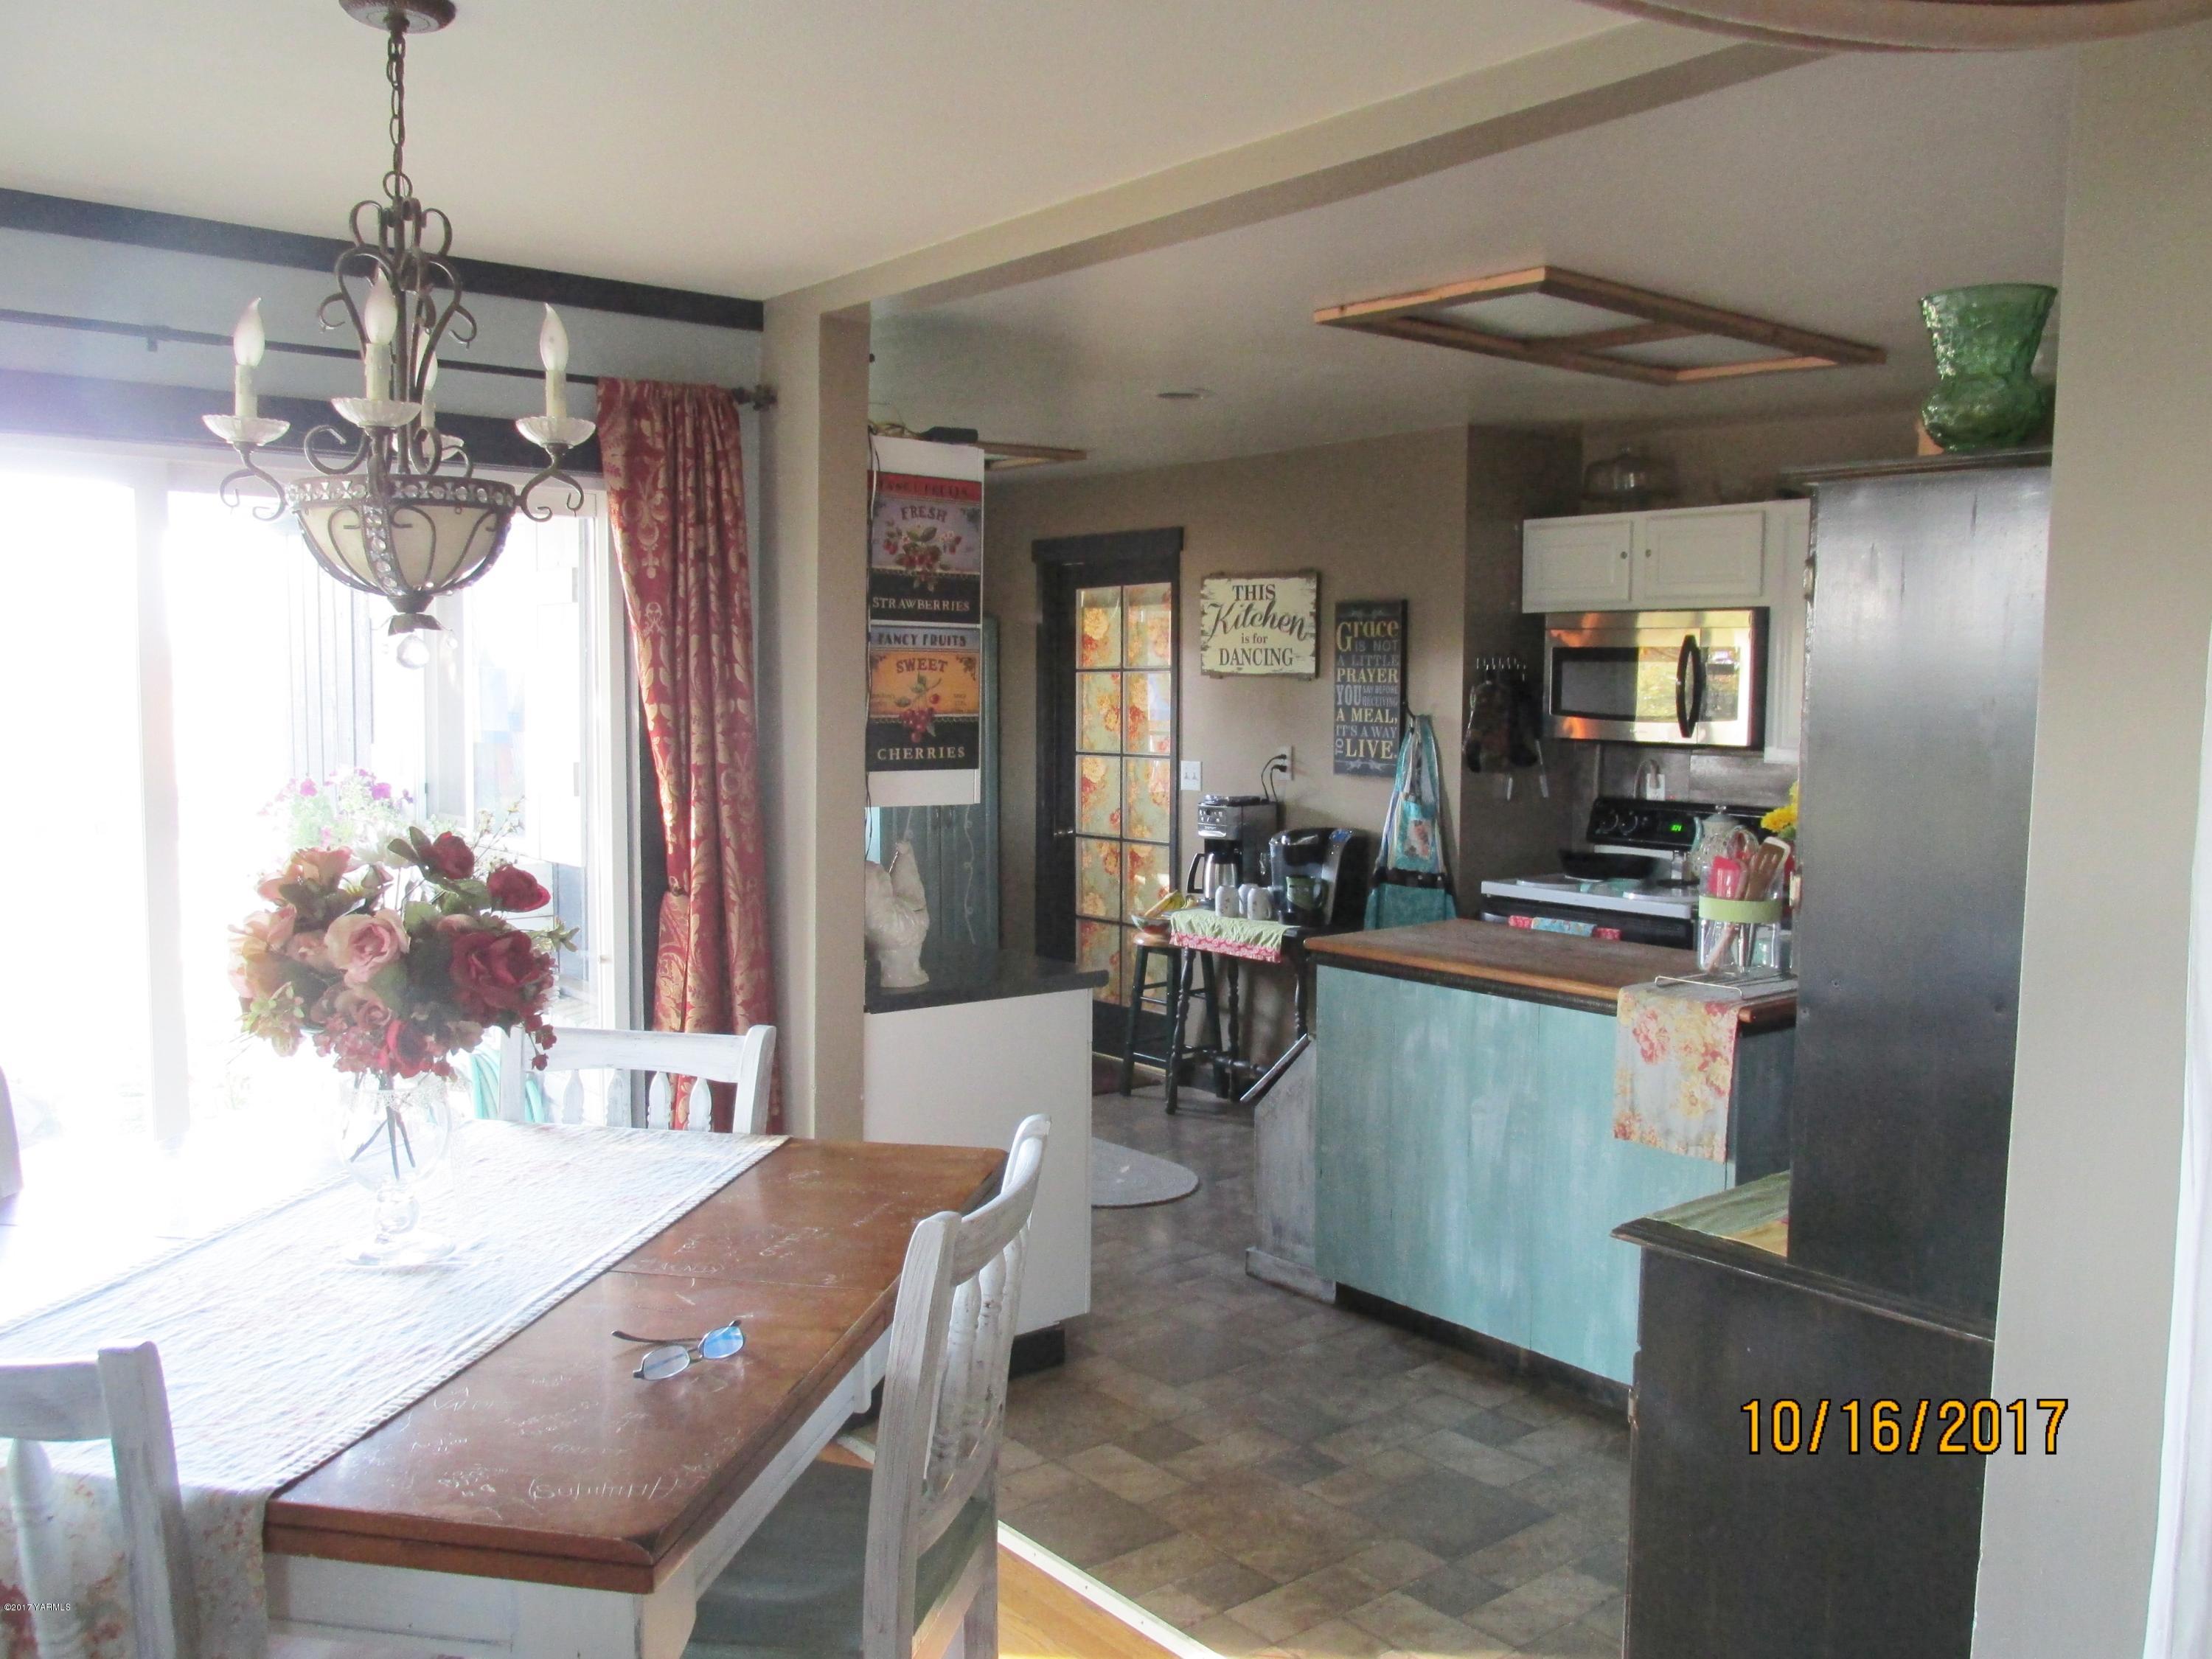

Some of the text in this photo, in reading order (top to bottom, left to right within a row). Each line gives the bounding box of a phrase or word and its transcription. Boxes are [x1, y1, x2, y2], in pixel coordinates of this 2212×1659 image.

[900, 505, 947, 523] FRESH
[1232, 584, 1276, 602] THIS
[872, 597, 970, 611] STRAWBERRIES
[1207, 600, 1309, 643] Kitchen
[878, 633, 967, 647] FANCY FRUITS
[1241, 633, 1268, 644] is for
[1336, 620, 1399, 652] Grace
[1355, 639, 1399, 652] IS NOT
[1219, 647, 1293, 666] DANCING
[1338, 654, 1399, 667] A LITTLE
[897, 658, 948, 673] SWEET
[1337, 667, 1399, 684] PRAYER
[1336, 684, 1362, 706] YOU
[1336, 708, 1398, 724] A MEAL,
[1336, 725, 1397, 738] IT'S A WAY
[877, 747, 965, 760] CHERRIES
[1335, 738, 1397, 759] TO LIVE.
